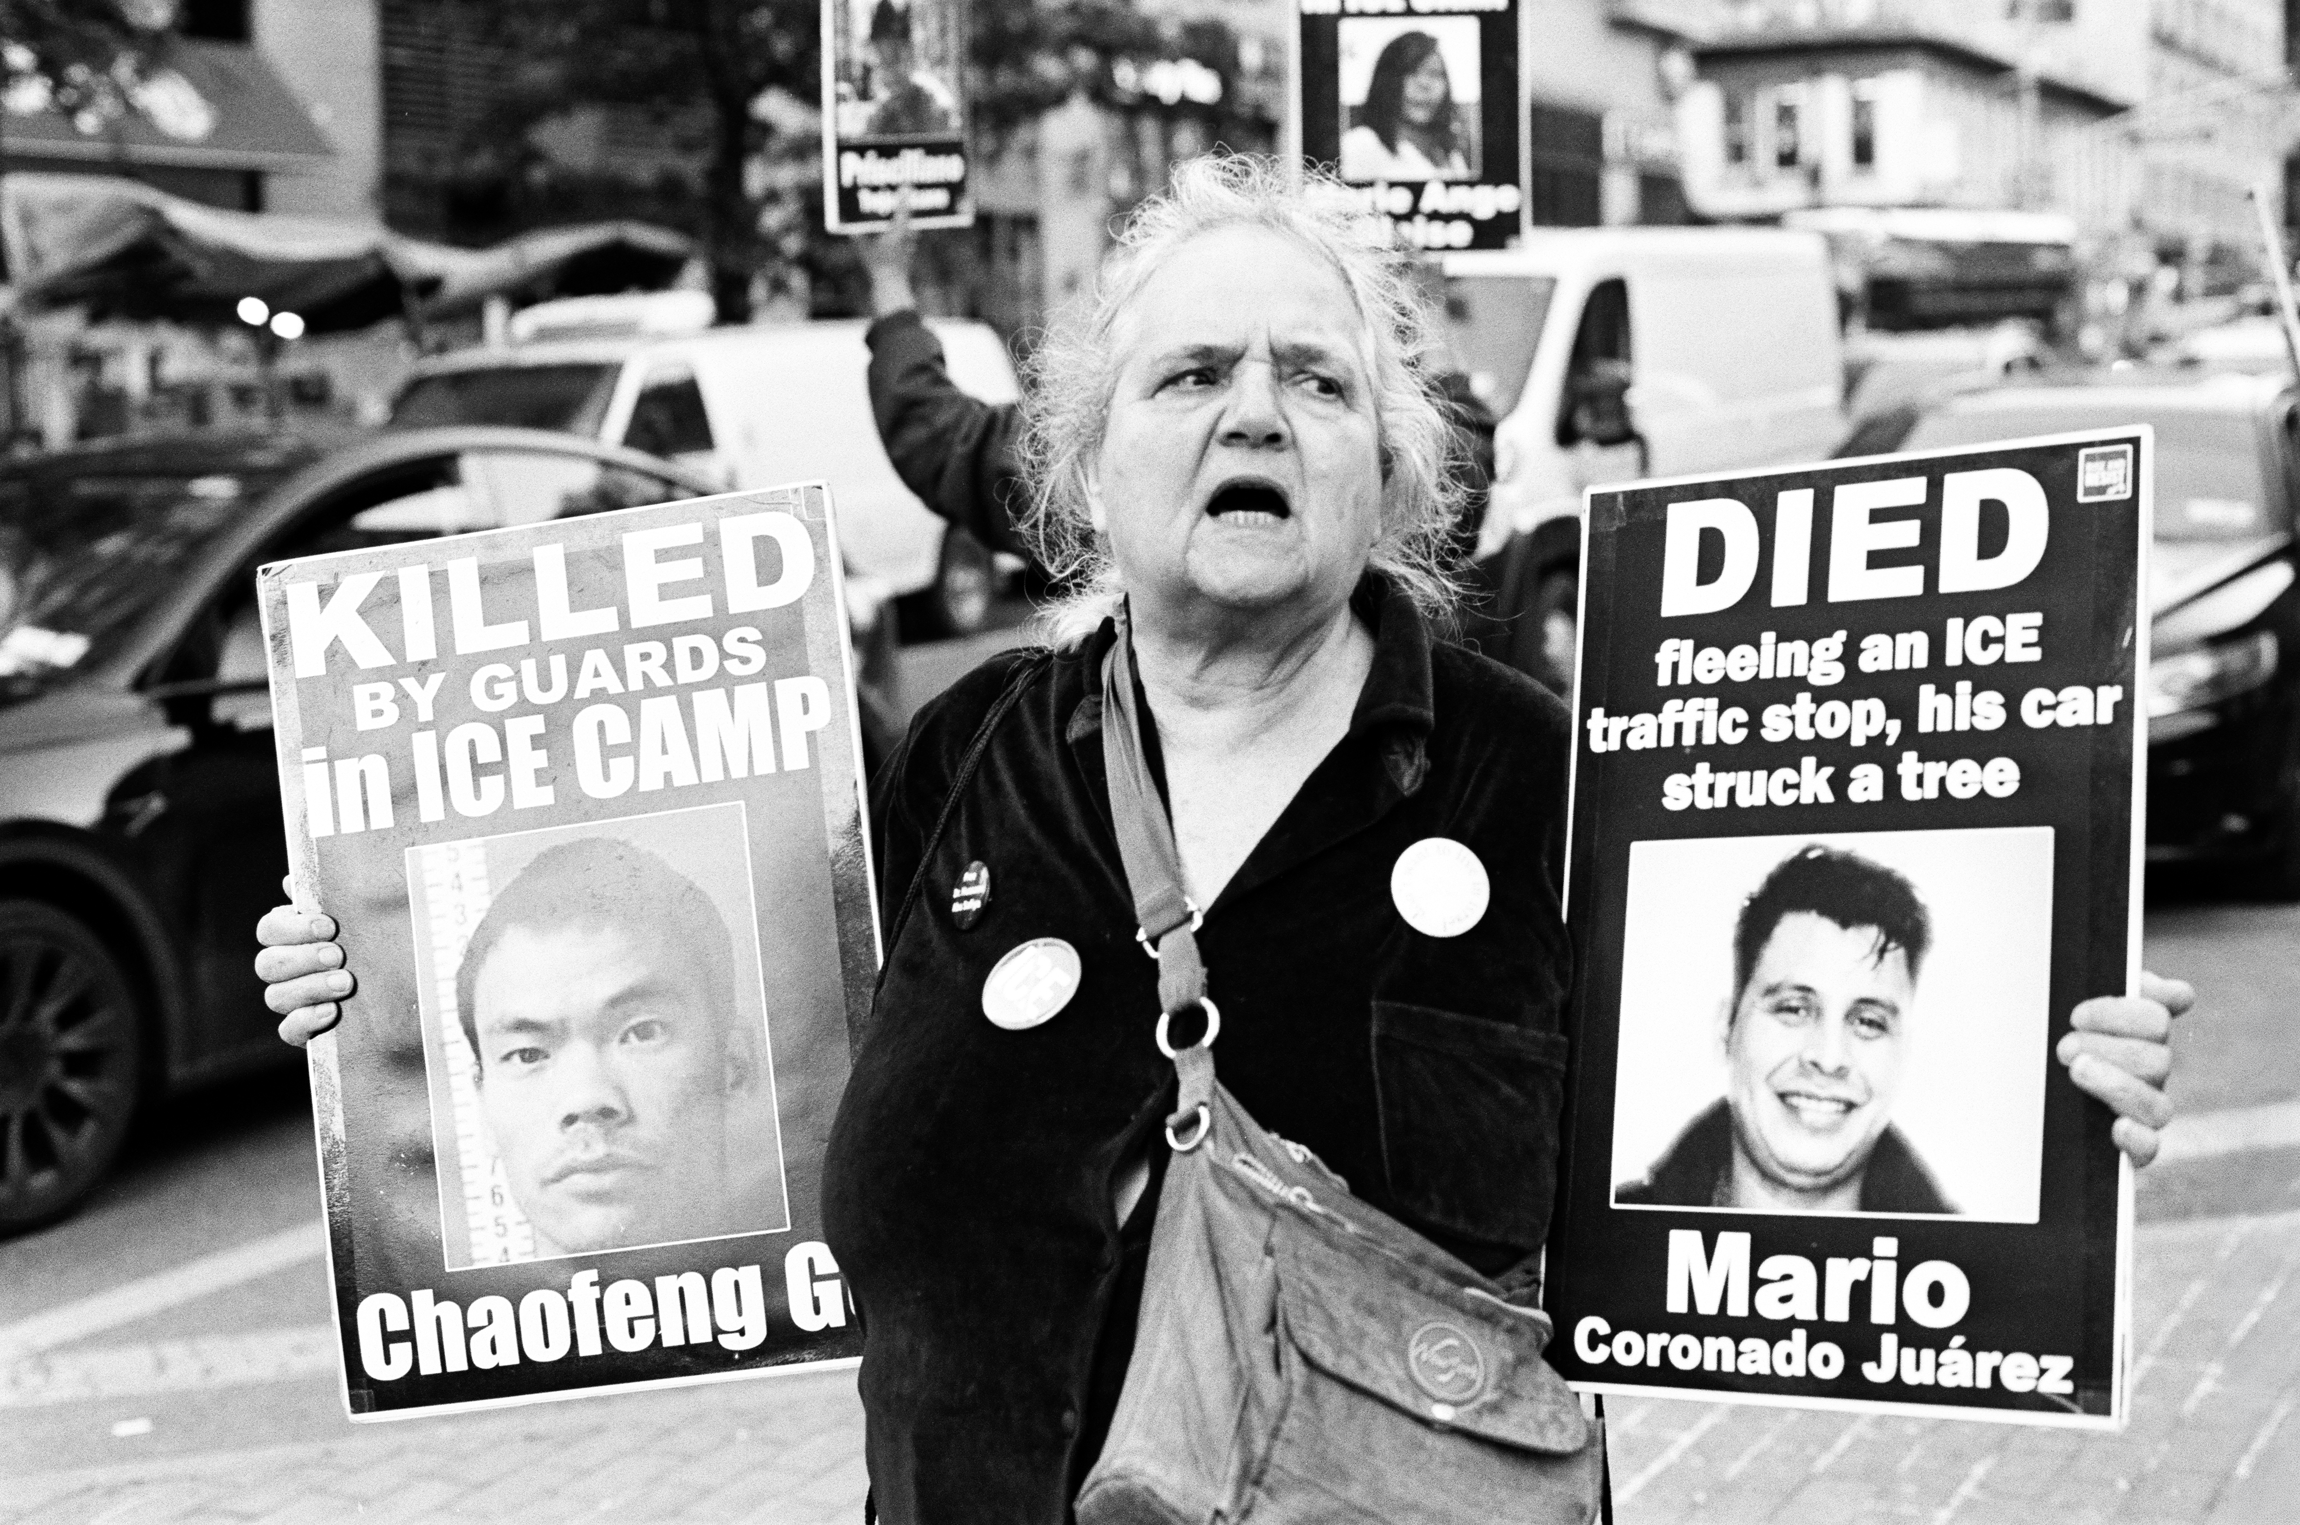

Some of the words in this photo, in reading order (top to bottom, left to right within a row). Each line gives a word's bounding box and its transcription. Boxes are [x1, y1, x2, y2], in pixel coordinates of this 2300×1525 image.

[1660, 468, 2049, 618] DIED
[286, 510, 815, 679] KILLED
[353, 672, 446, 731] BY
[469, 626, 766, 712] GUARDS
[1654, 630, 1847, 687] fleeing
[1858, 630, 1929, 673] an
[1945, 612, 2043, 667] ICE
[301, 746, 394, 838] in
[411, 714, 556, 823] ICE
[572, 676, 832, 799] CAMP
[1586, 697, 1749, 753] traffic
[1760, 692, 1901, 747] stop,
[1918, 680, 2007, 733] his
[2020, 685, 2123, 729] car
[1661, 756, 1835, 811] struck
[1847, 763, 1884, 803] a
[1897, 751, 2020, 801] tree
[357, 1265, 767, 1381] Chaofeng
[784, 1241, 858, 1331] G
[1666, 1229, 1970, 1329] Mario
[1574, 1316, 1845, 1380] Coronado
[1861, 1334, 2074, 1394] Juárez
